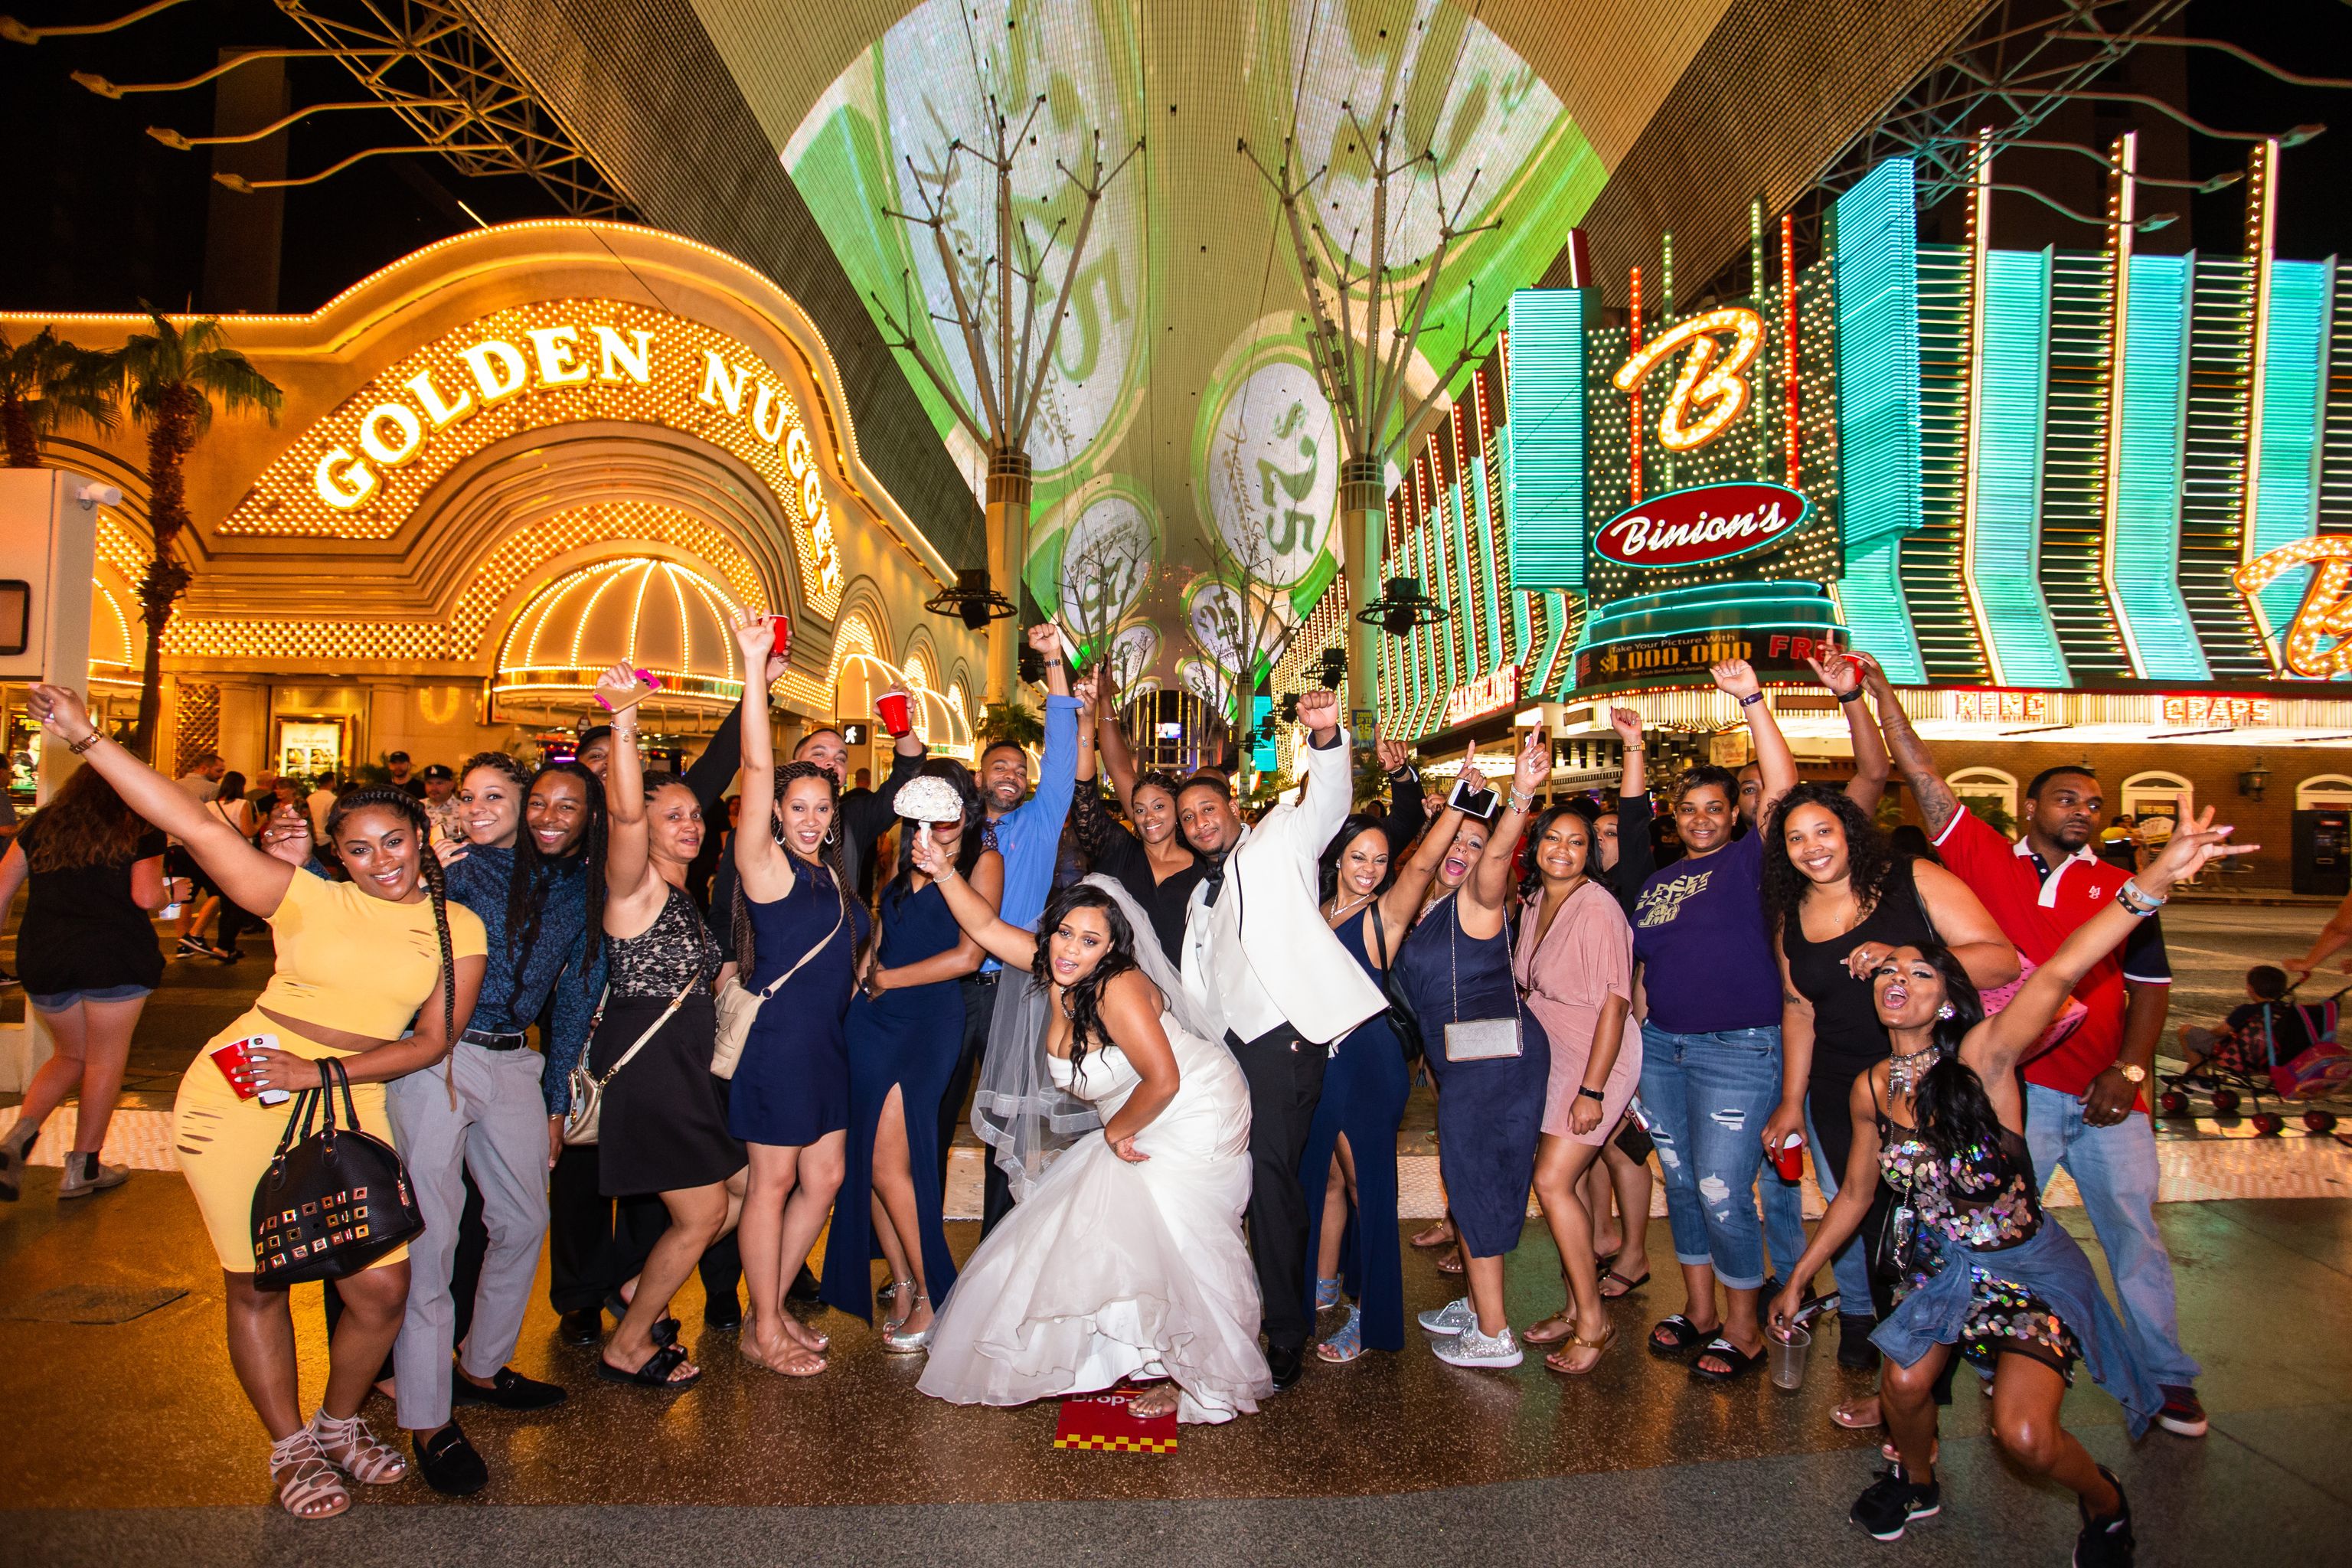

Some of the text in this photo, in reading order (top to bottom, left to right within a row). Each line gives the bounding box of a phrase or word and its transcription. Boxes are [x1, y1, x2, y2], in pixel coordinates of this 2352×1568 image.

[1612, 306, 1763, 450] B
[313, 325, 842, 596] GOLDEN NUGGET
[1609, 501, 1787, 557] Binion's
[1611, 633, 1736, 654] Take Your Picture With
[1769, 635, 1841, 662] FRE
[1599, 641, 1752, 674] $1,000,000
[2165, 697, 2271, 721] CRAPS
[1357, 724, 1371, 734] 35
[1072, 1393, 1140, 1406] Drop-
